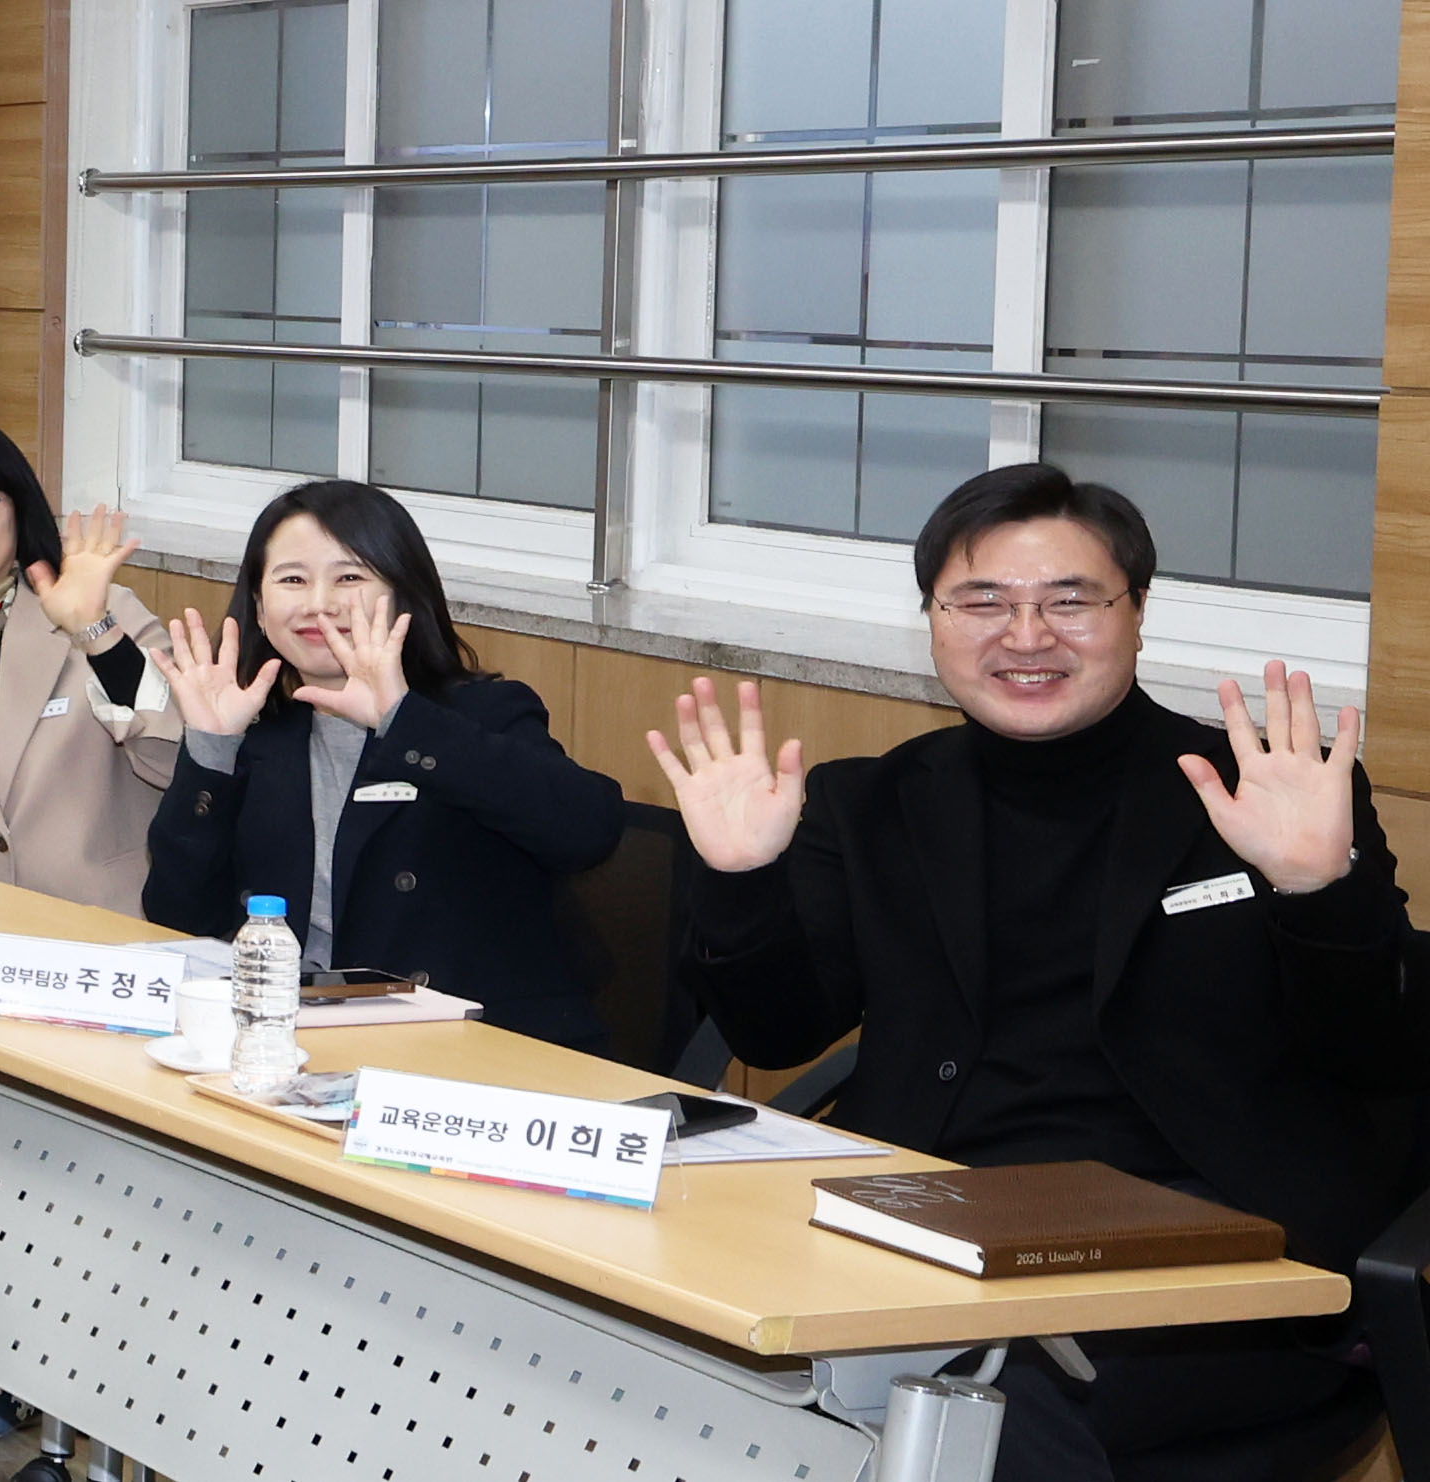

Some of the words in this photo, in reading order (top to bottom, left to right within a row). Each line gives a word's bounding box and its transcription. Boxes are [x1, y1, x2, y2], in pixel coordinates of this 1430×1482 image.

[75, 966, 172, 1004] 주정숙
[378, 1103, 509, 1144] 교육운영부장
[525, 1116, 650, 1166] 이희훈
[1015, 1251, 1044, 1266] 2026
[1048, 1249, 1086, 1264] Usually
[1089, 1247, 1103, 1261] 18
